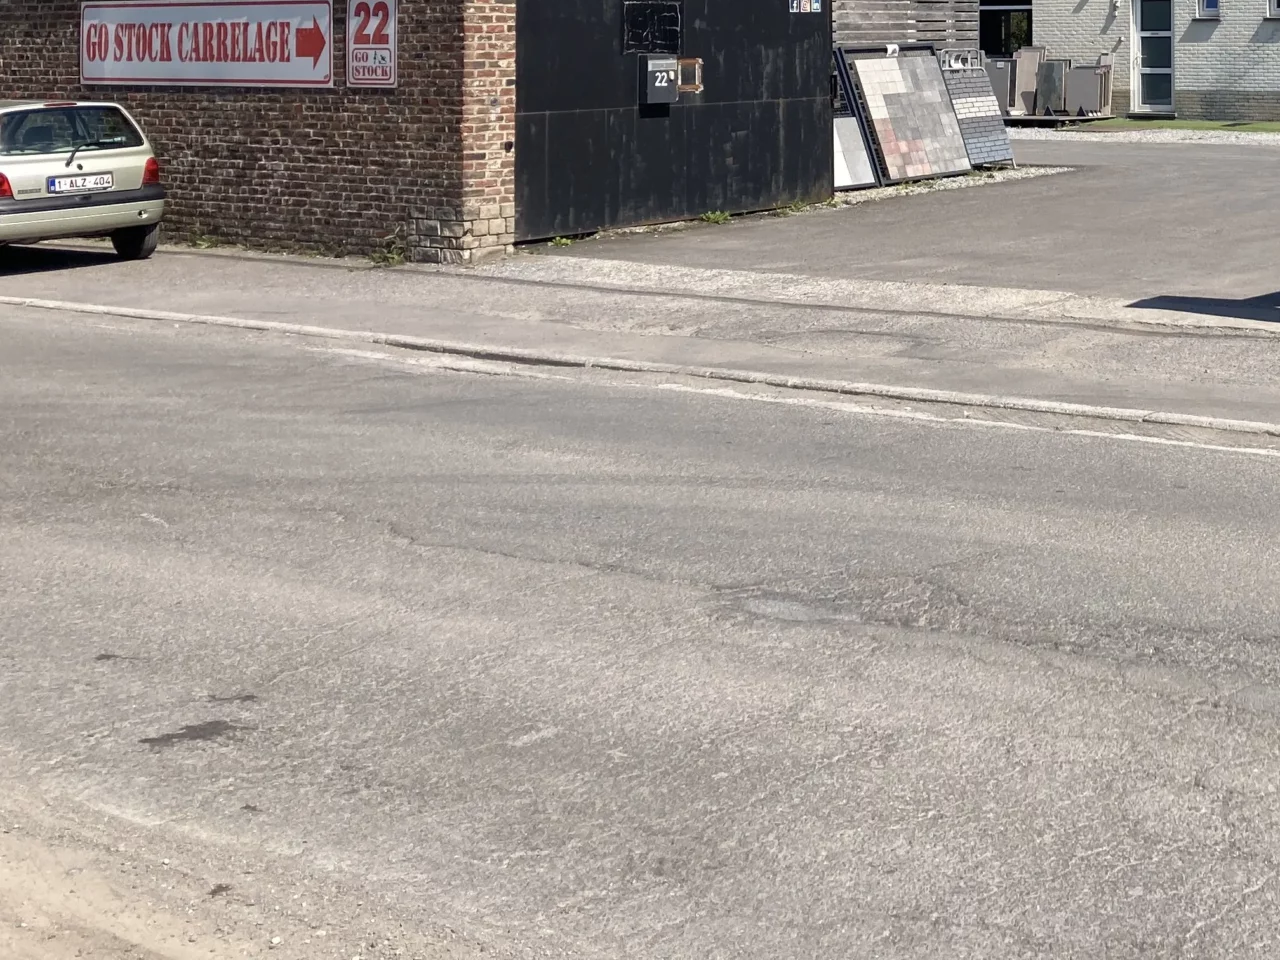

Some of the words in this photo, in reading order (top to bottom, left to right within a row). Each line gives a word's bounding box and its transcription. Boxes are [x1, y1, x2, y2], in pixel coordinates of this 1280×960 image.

[353, 1, 389, 45] 22
[86, 23, 109, 63] GO
[113, 22, 173, 63] STOCK
[177, 21, 291, 63] CARRELAGE
[354, 51, 369, 63] GO
[354, 65, 389, 77] STOCK
[655, 72, 668, 87] 22
